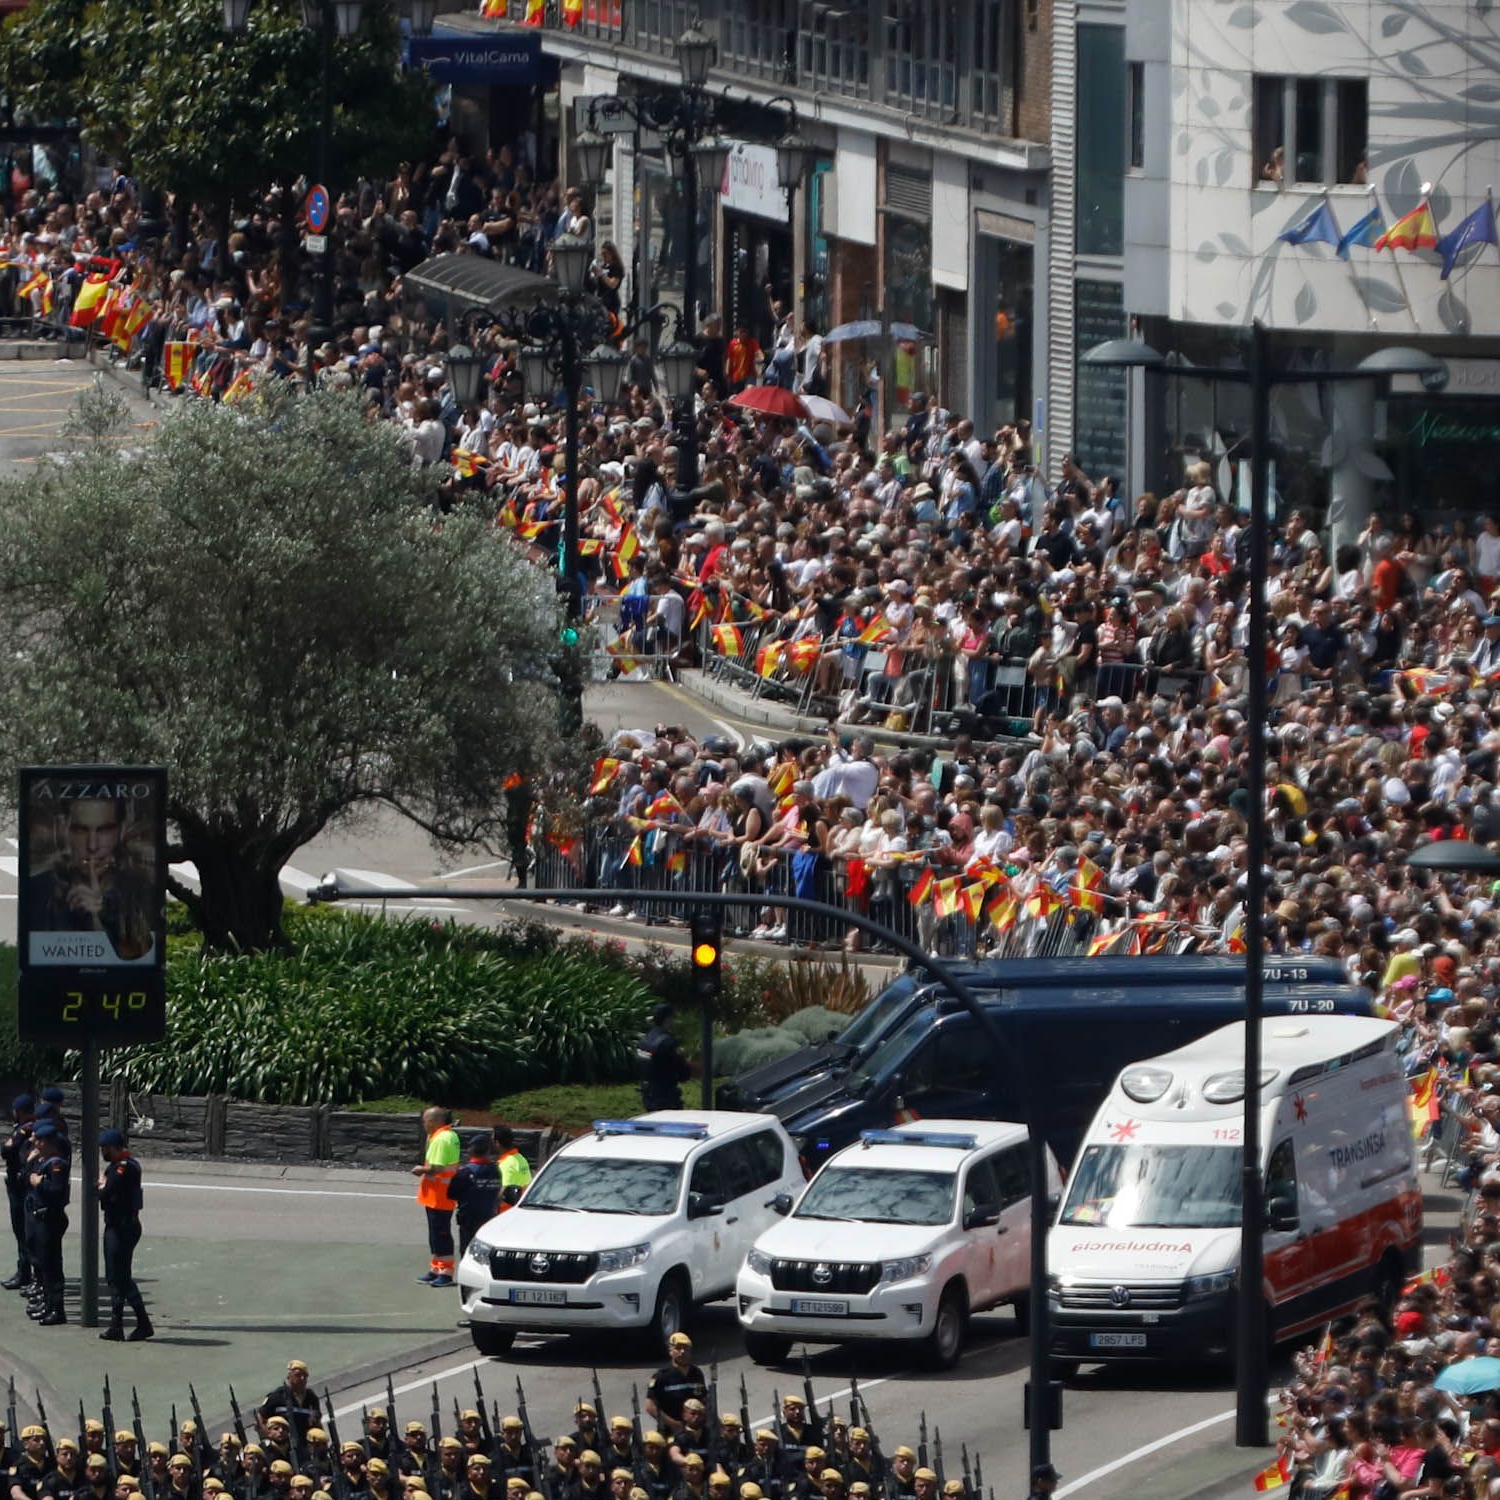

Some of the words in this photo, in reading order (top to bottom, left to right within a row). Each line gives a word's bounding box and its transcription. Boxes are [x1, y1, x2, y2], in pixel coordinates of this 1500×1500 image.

[455, 50, 529, 64] VitalCama
[38, 783, 150, 800] AZZARO
[42, 945, 105, 958] WANTED
[1212, 1129, 1240, 1140] 112
[1330, 1130, 1386, 1170] TRANSINSA
